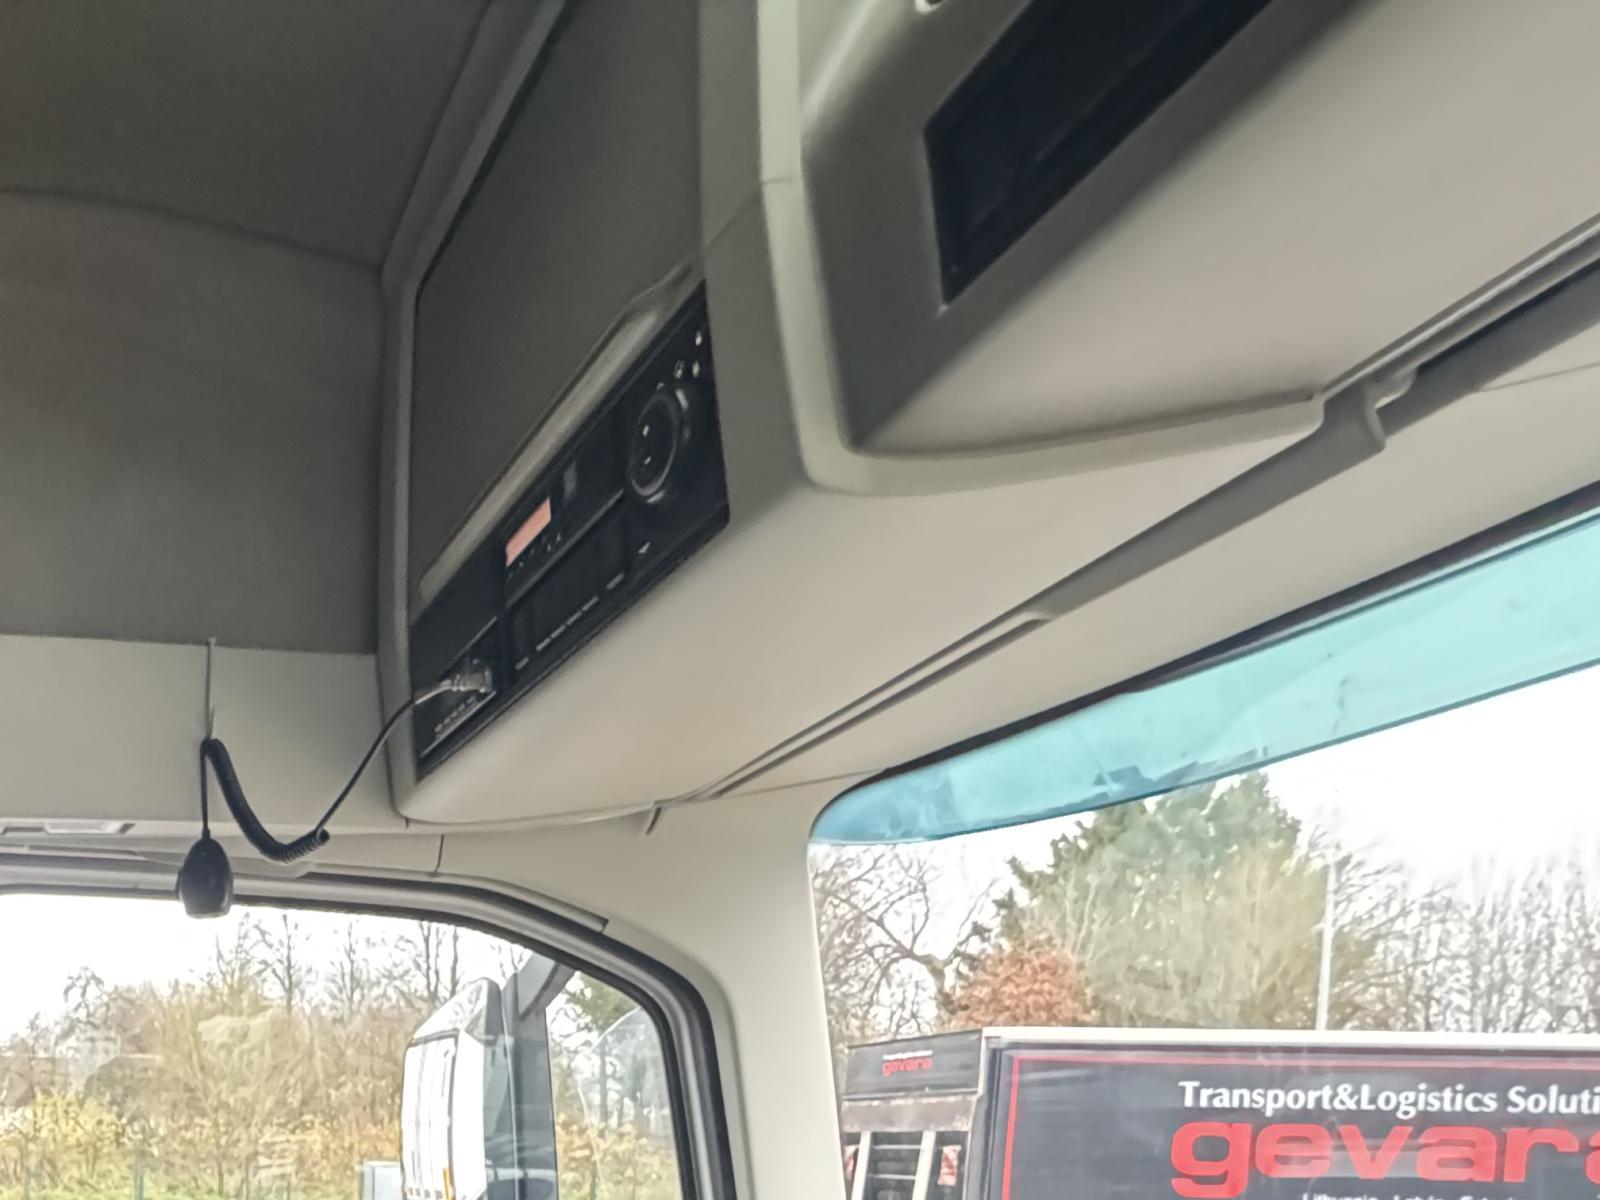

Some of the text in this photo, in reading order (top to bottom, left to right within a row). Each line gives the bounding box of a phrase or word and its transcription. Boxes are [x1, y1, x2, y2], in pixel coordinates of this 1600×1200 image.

[883, 1057, 933, 1077] gevara
[1178, 1080, 1498, 1120] Transport&Logistics
[1170, 1121, 1600, 1198] gevar
